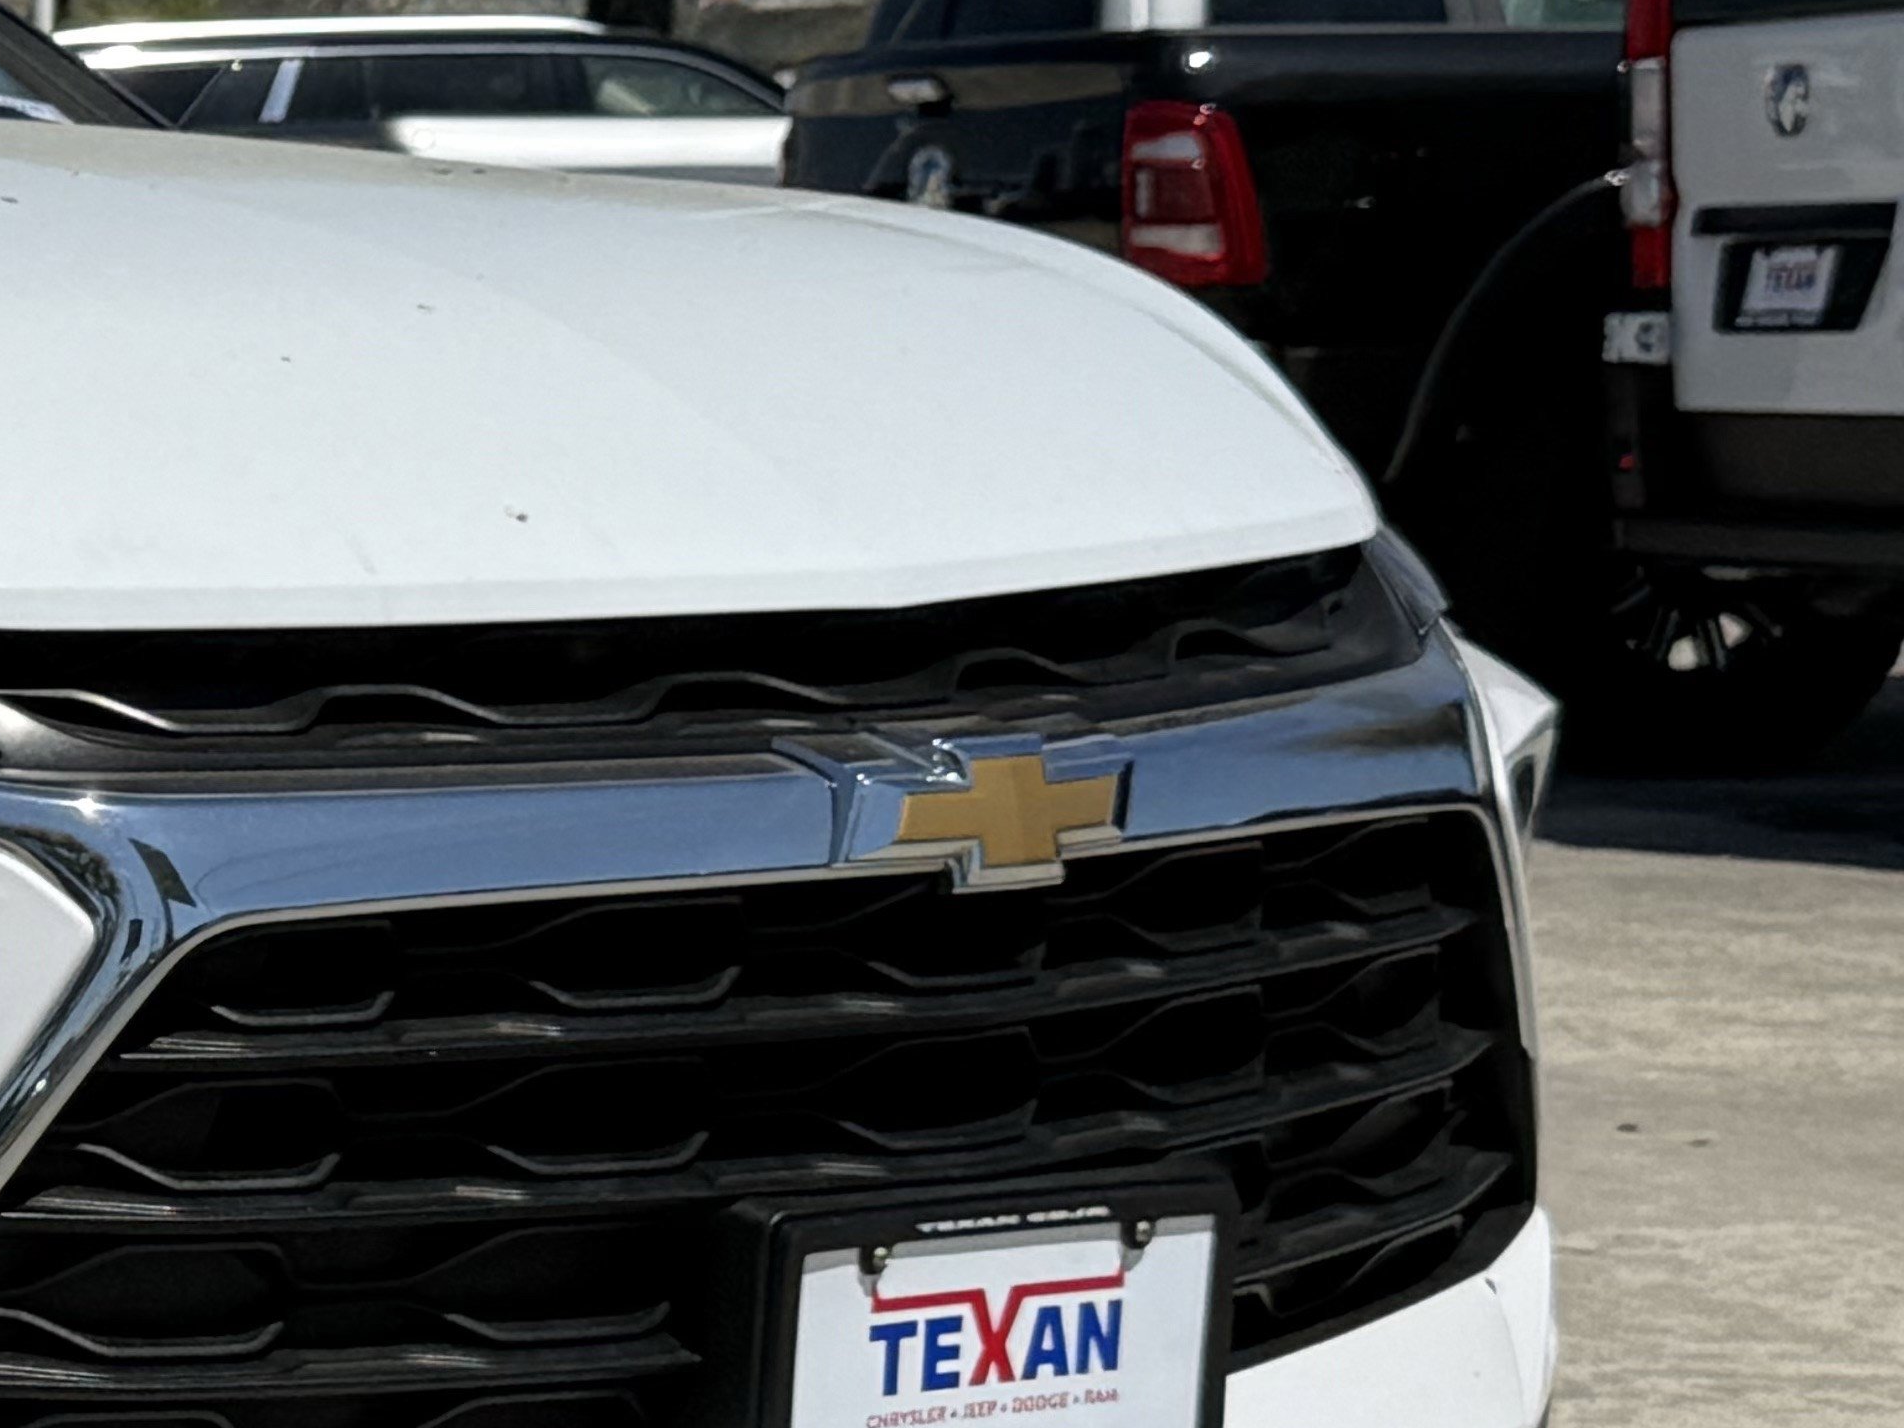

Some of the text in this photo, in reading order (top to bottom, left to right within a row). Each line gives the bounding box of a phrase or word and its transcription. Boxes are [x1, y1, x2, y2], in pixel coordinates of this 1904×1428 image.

[869, 1270, 1124, 1397] TEXAN
[963, 1400, 998, 1420] JEEP
[1012, 1392, 1070, 1414] DODGE
[1084, 1387, 1119, 1404] RAM
